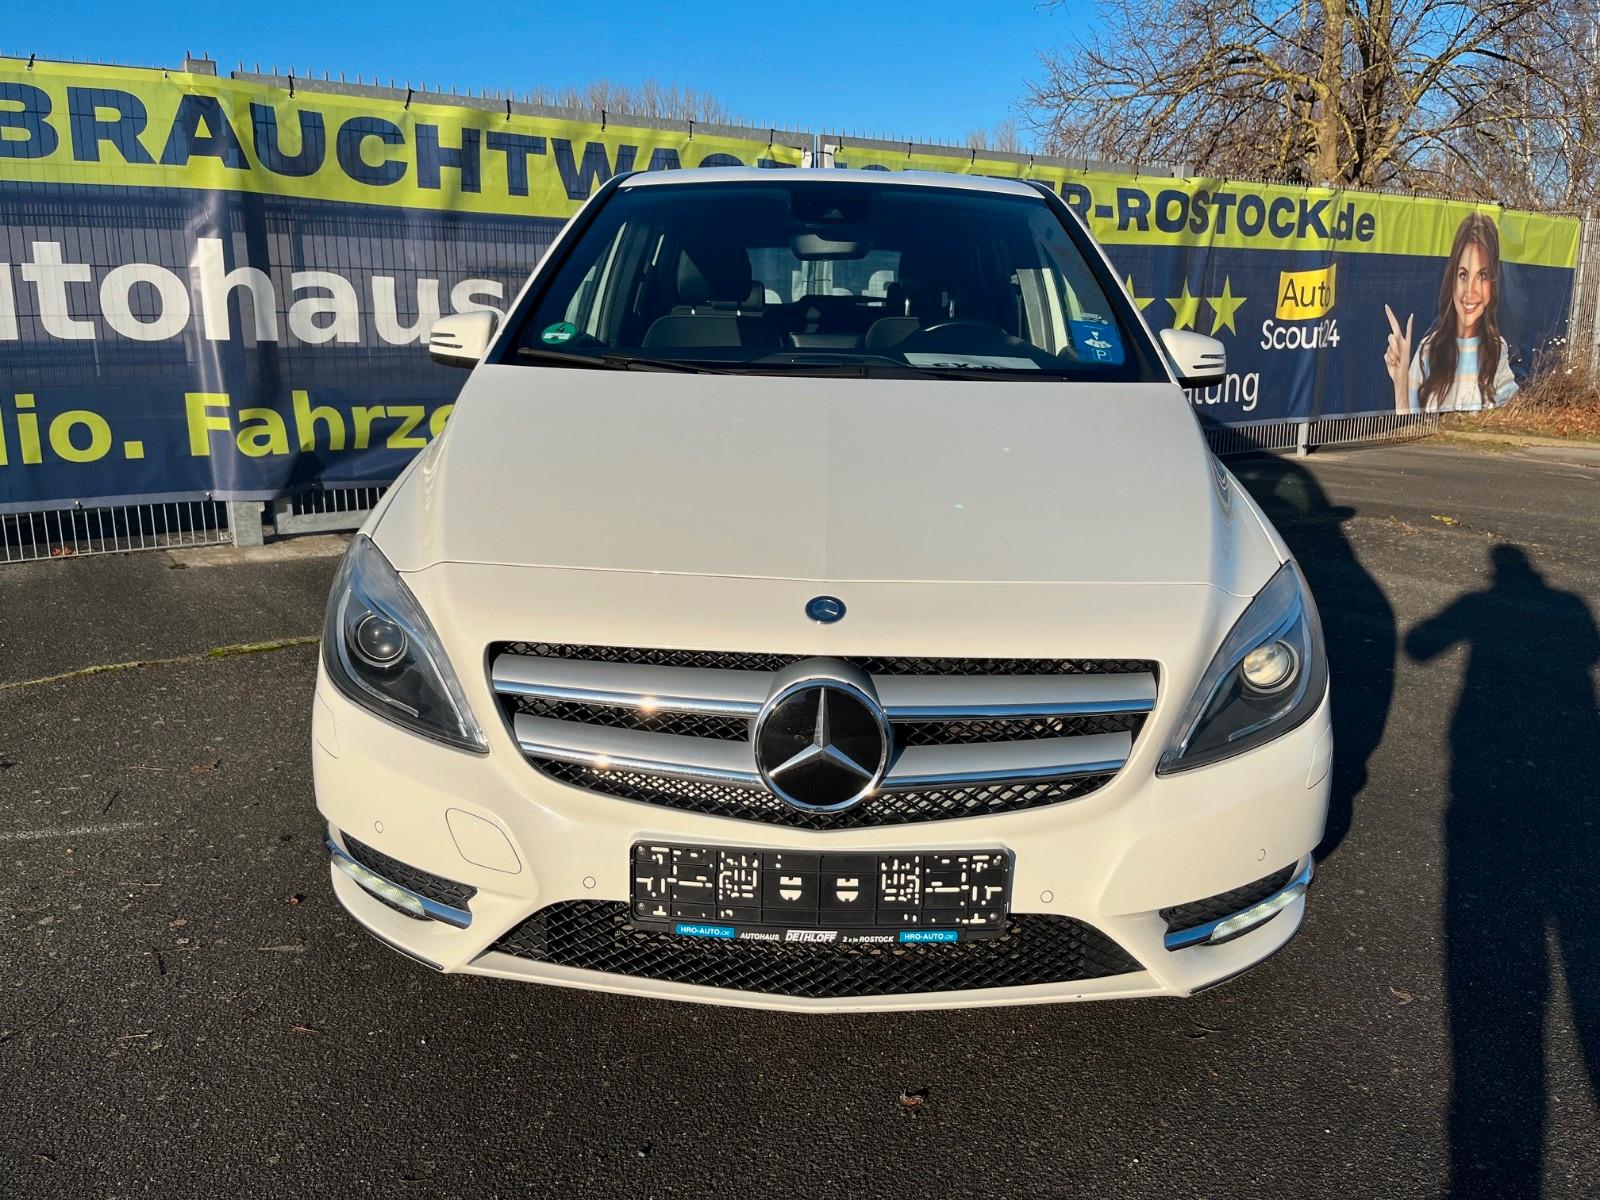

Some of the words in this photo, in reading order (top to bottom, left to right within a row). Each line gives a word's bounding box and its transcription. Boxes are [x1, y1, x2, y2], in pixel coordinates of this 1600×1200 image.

[1034, 180, 1376, 242] R-ROSTOCK.de
[0, 237, 507, 345] tohaus
[1280, 278, 1330, 307] Auto
[1260, 319, 1340, 350] Scout24
[0, 393, 144, 466] io.
[680, 926, 730, 936] HRO-AUTO.de
[740, 932, 780, 940] AUTOHAUS
[785, 930, 838, 943] DETHLOFF
[904, 932, 954, 940] HRO-AUTO.de
